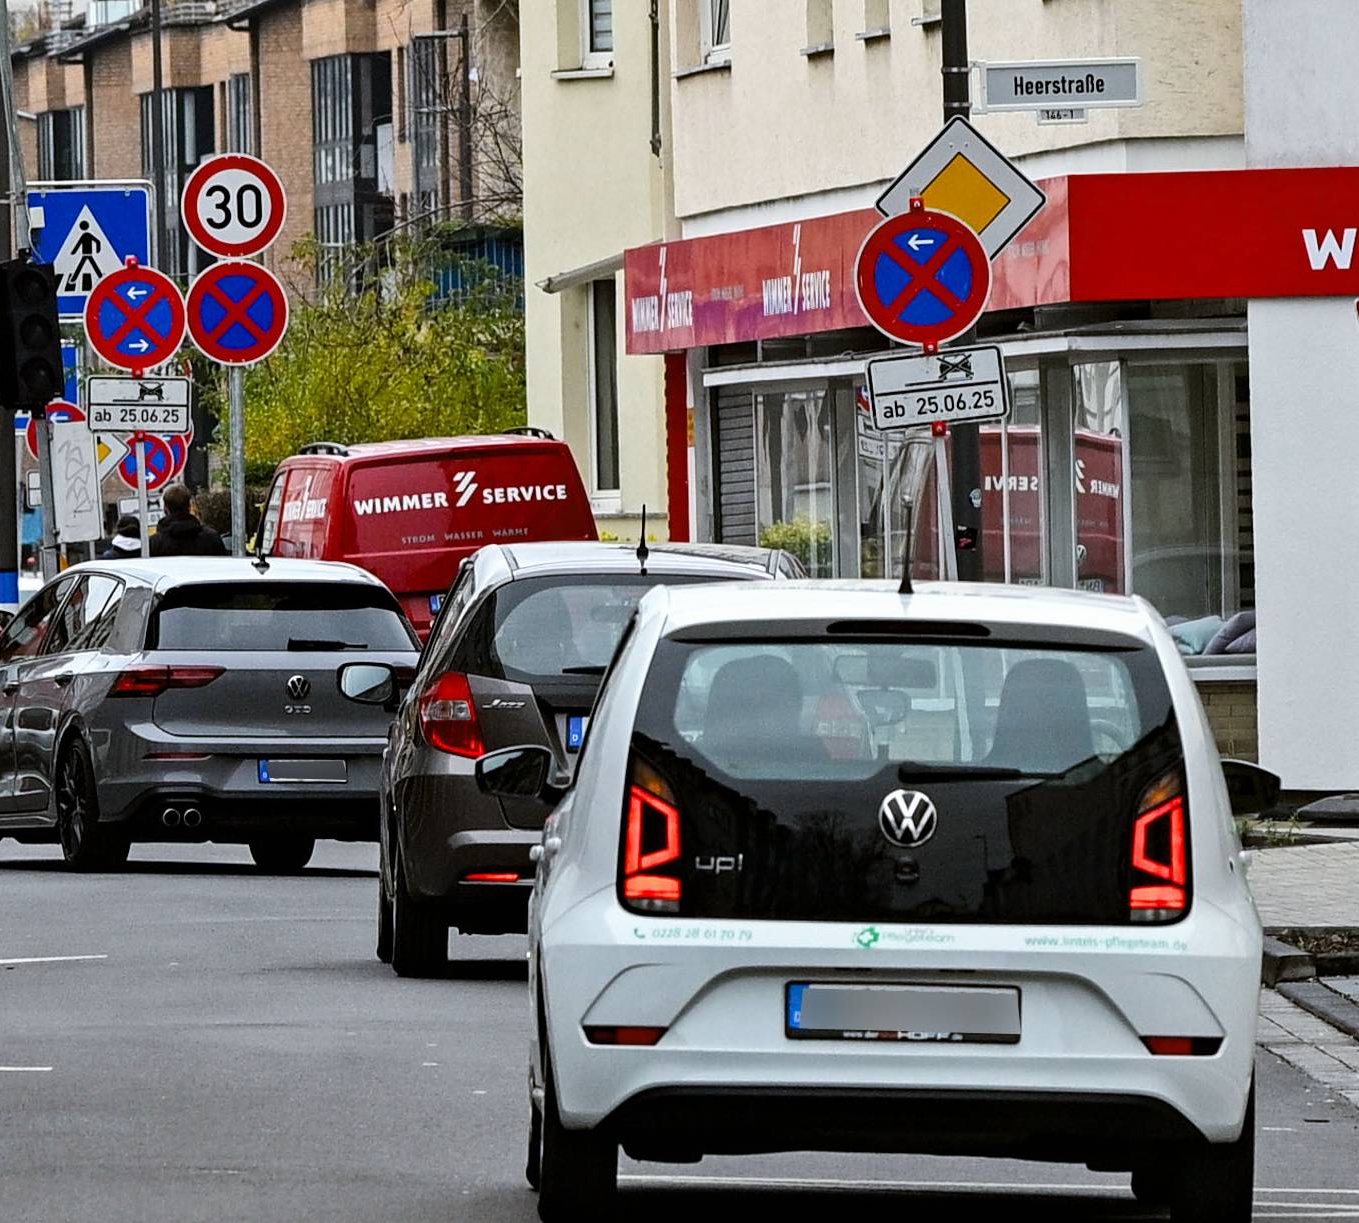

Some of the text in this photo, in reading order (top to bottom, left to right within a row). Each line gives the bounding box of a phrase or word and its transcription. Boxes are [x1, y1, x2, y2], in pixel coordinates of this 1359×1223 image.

[1014, 74, 1105, 96] Heerstraße
[205, 183, 263, 229] 30
[1302, 228, 1357, 270] W
[94, 409, 179, 423] ab 25.06.25
[883, 390, 994, 418] ab 25.06.25
[353, 484, 568, 516] WIMMER SERVICE
[695, 853, 744, 874] up!
